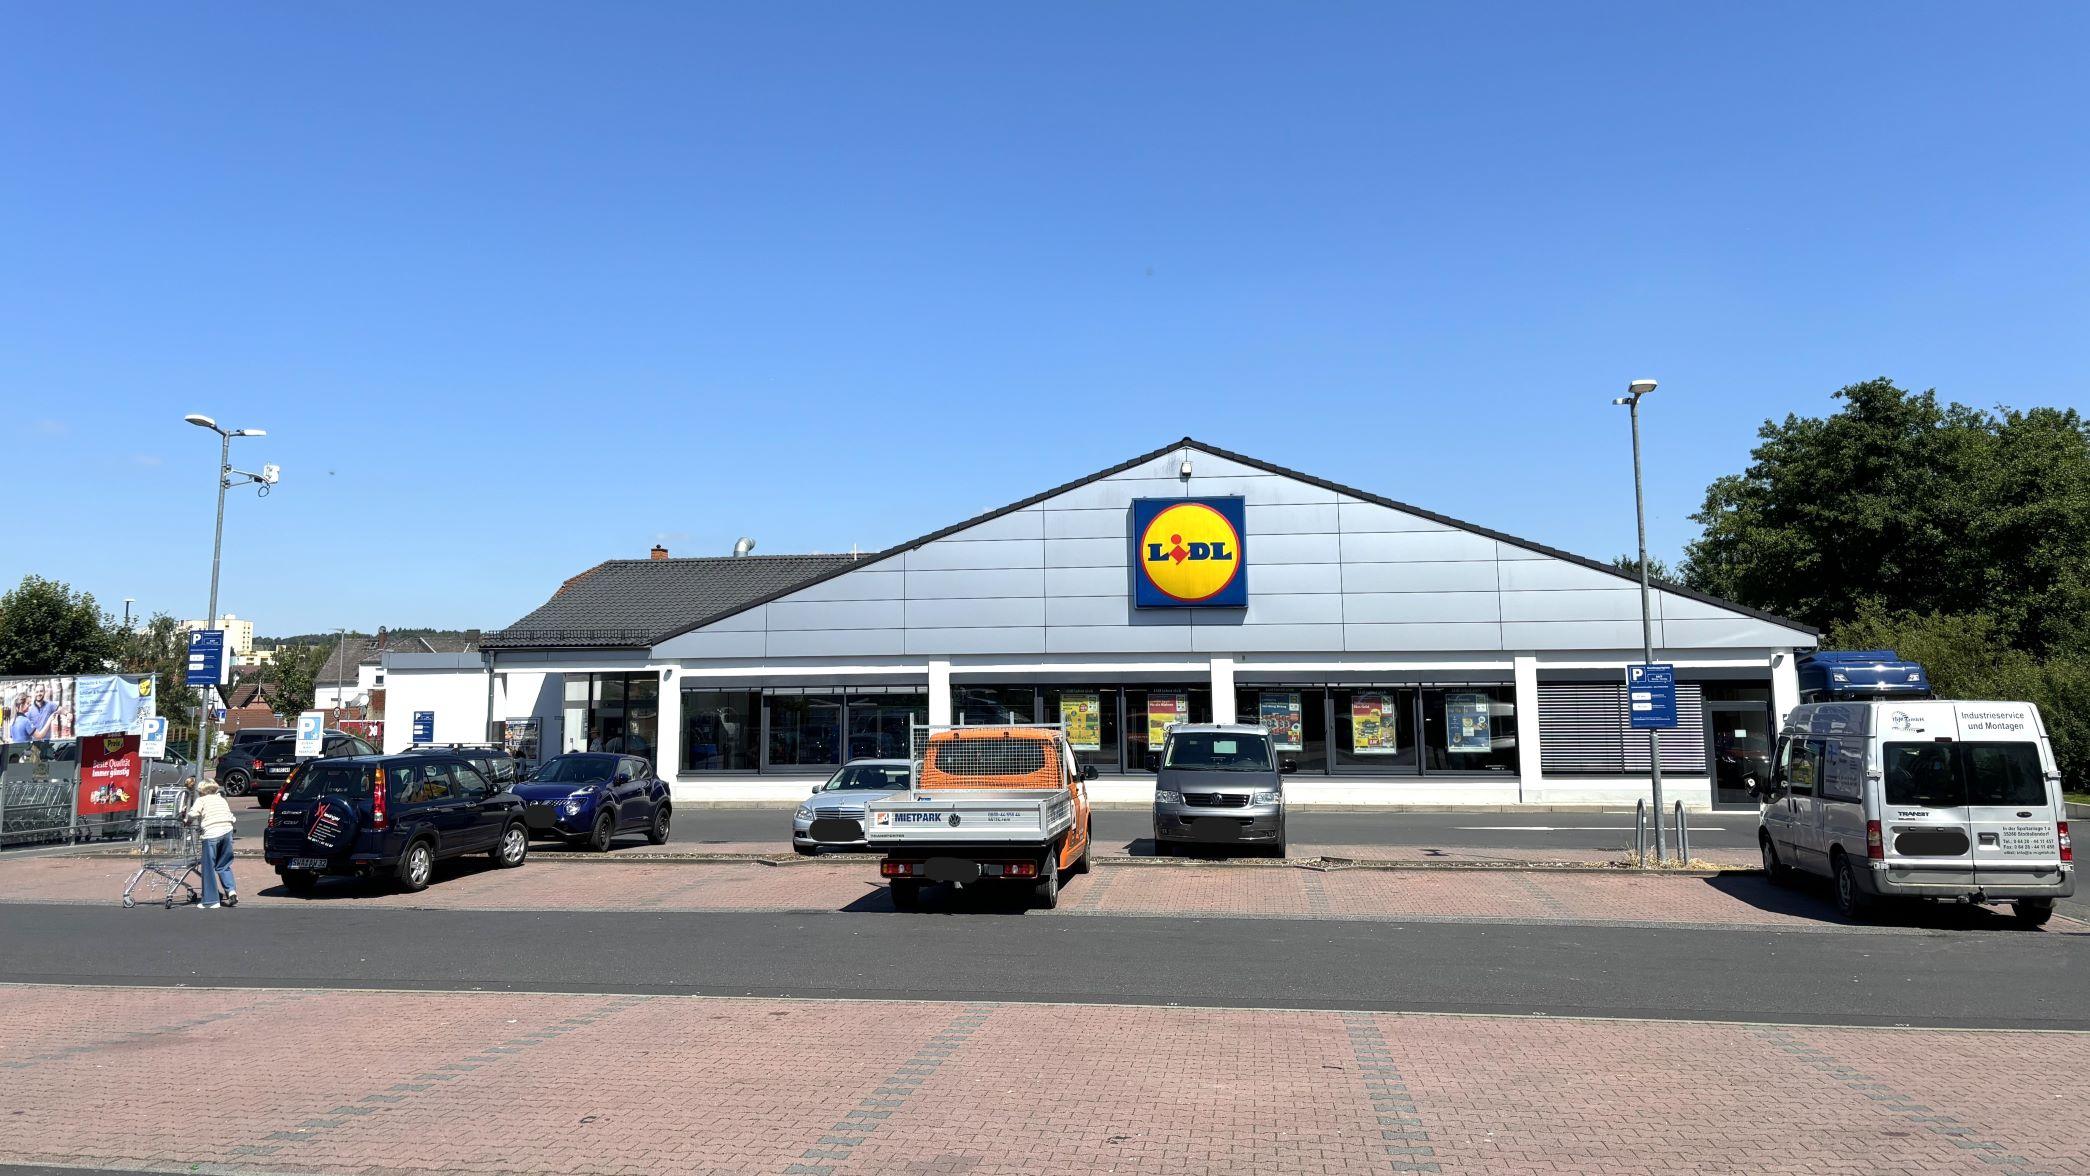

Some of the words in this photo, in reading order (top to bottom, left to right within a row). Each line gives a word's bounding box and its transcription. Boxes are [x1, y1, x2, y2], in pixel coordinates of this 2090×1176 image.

[192, 633, 201, 644] P
[1632, 668, 1643, 680] P
[143, 719, 160, 740] P
[299, 718, 315, 740] P
[1968, 722, 1983, 730] und
[1985, 722, 2024, 731] Montagen
[110, 767, 130, 778] günstig
[894, 812, 942, 823] MIETPARK
